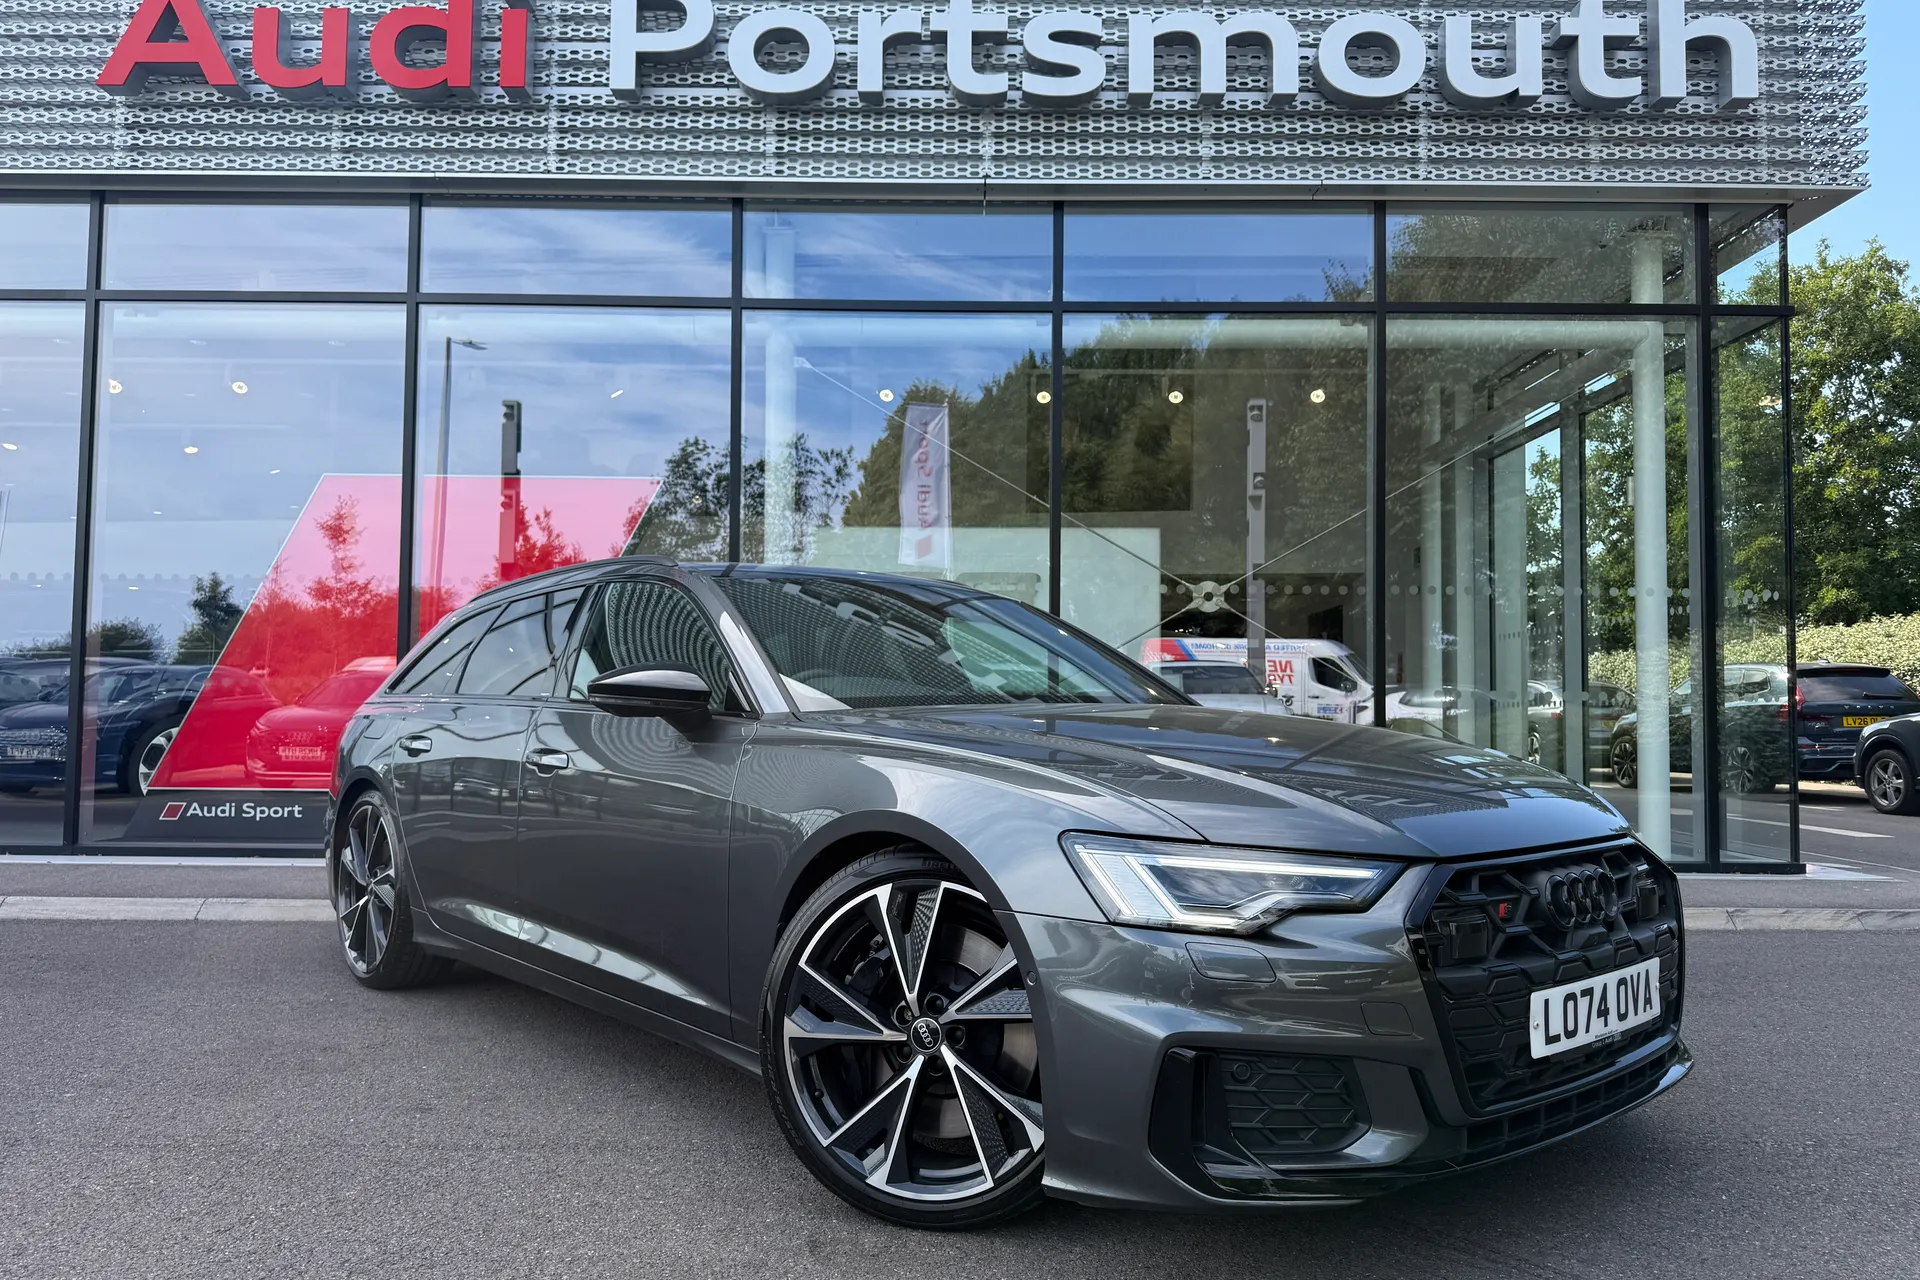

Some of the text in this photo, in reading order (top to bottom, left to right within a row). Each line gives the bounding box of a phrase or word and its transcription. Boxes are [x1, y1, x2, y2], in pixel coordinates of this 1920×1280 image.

[96, 0, 1760, 101] Audi Portsmouth
[1846, 717, 1868, 725] LV26
[186, 802, 303, 821] Audi Sport
[1543, 968, 1653, 1046] LO74 OVA
